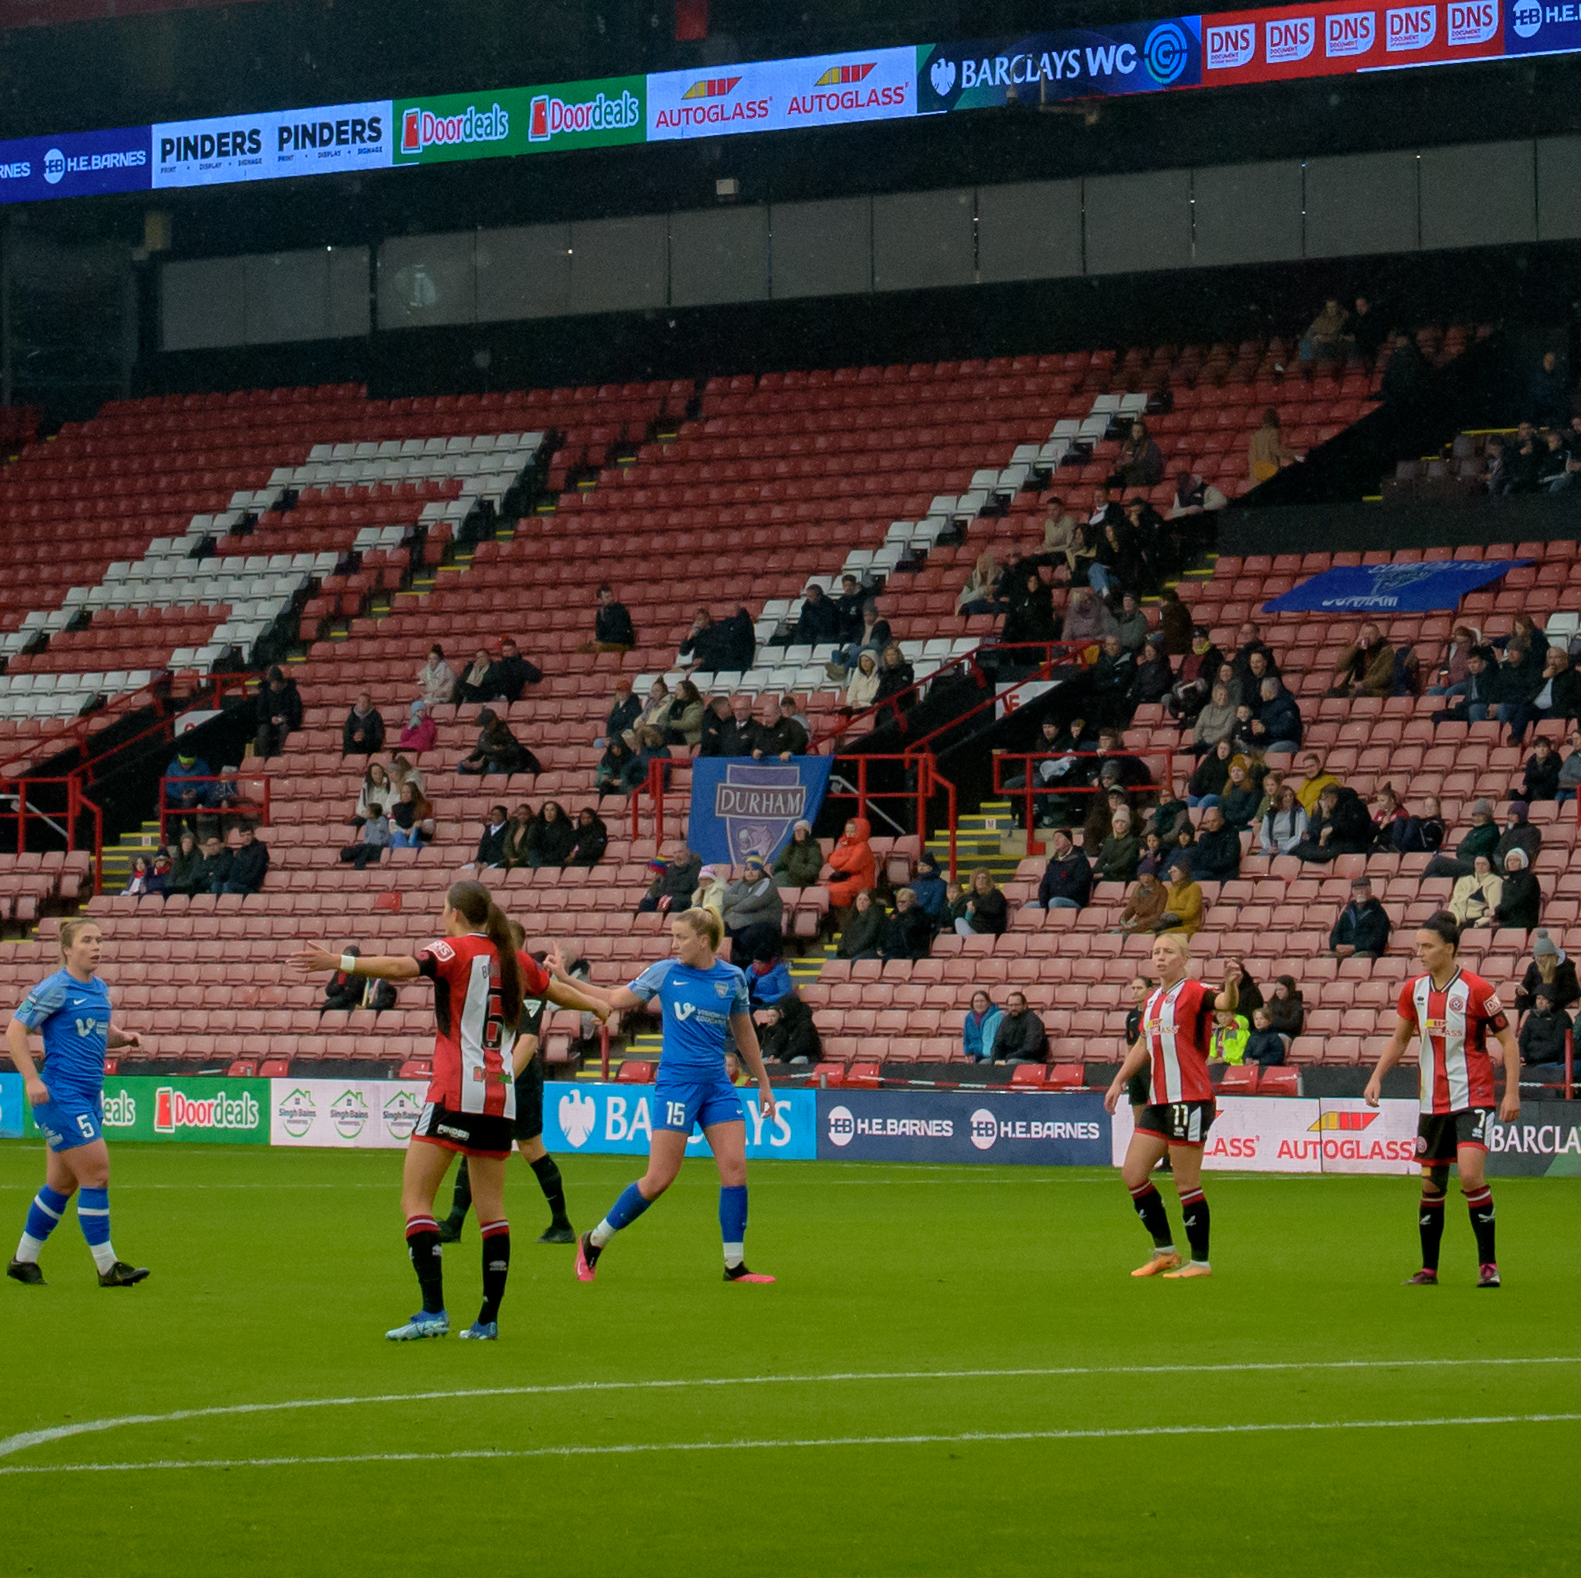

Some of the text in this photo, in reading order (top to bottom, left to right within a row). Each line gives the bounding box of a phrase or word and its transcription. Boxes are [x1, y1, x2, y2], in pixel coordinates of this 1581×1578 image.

[1330, 16, 1370, 42] DNS
[1390, 10, 1431, 35] DNS
[1452, 4, 1493, 29] DNS
[1211, 29, 1250, 53] DNS
[1271, 23, 1309, 48] DNS
[962, 43, 1137, 89] BARCLAYS WC
[423, 105, 507, 143] Doordeals
[551, 93, 638, 130] Doordeals
[161, 128, 262, 163] PINDERS
[277, 116, 383, 152] PINDERS
[721, 789, 801, 815] DURHAM
[175, 1092, 258, 1128] Doordeals
[666, 1101, 686, 1126] 15
[1173, 1105, 1188, 1126] 11
[1474, 1109, 1485, 1128] 7
[76, 1114, 95, 1138] 5
